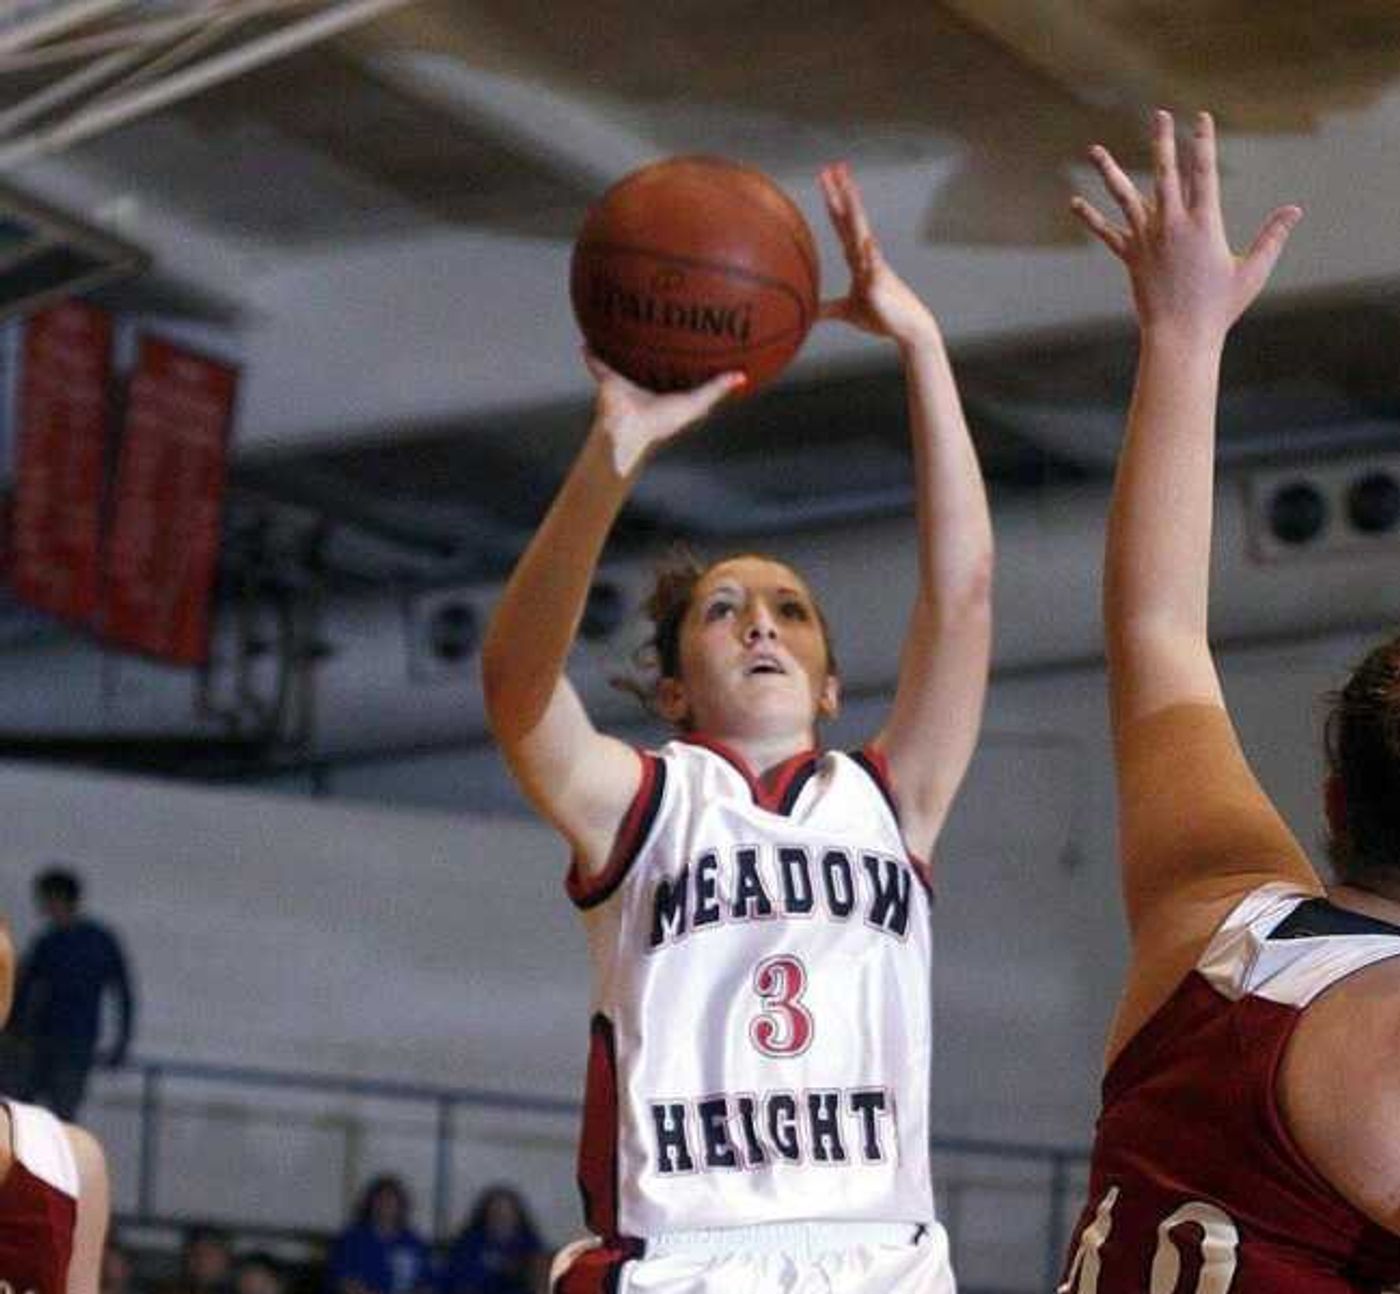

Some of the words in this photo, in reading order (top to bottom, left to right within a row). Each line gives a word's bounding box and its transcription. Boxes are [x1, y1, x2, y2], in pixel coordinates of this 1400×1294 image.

[650, 844, 913, 948] MEADOW
[749, 954, 815, 1058] 3
[650, 1086, 892, 1177] HEIGHT
